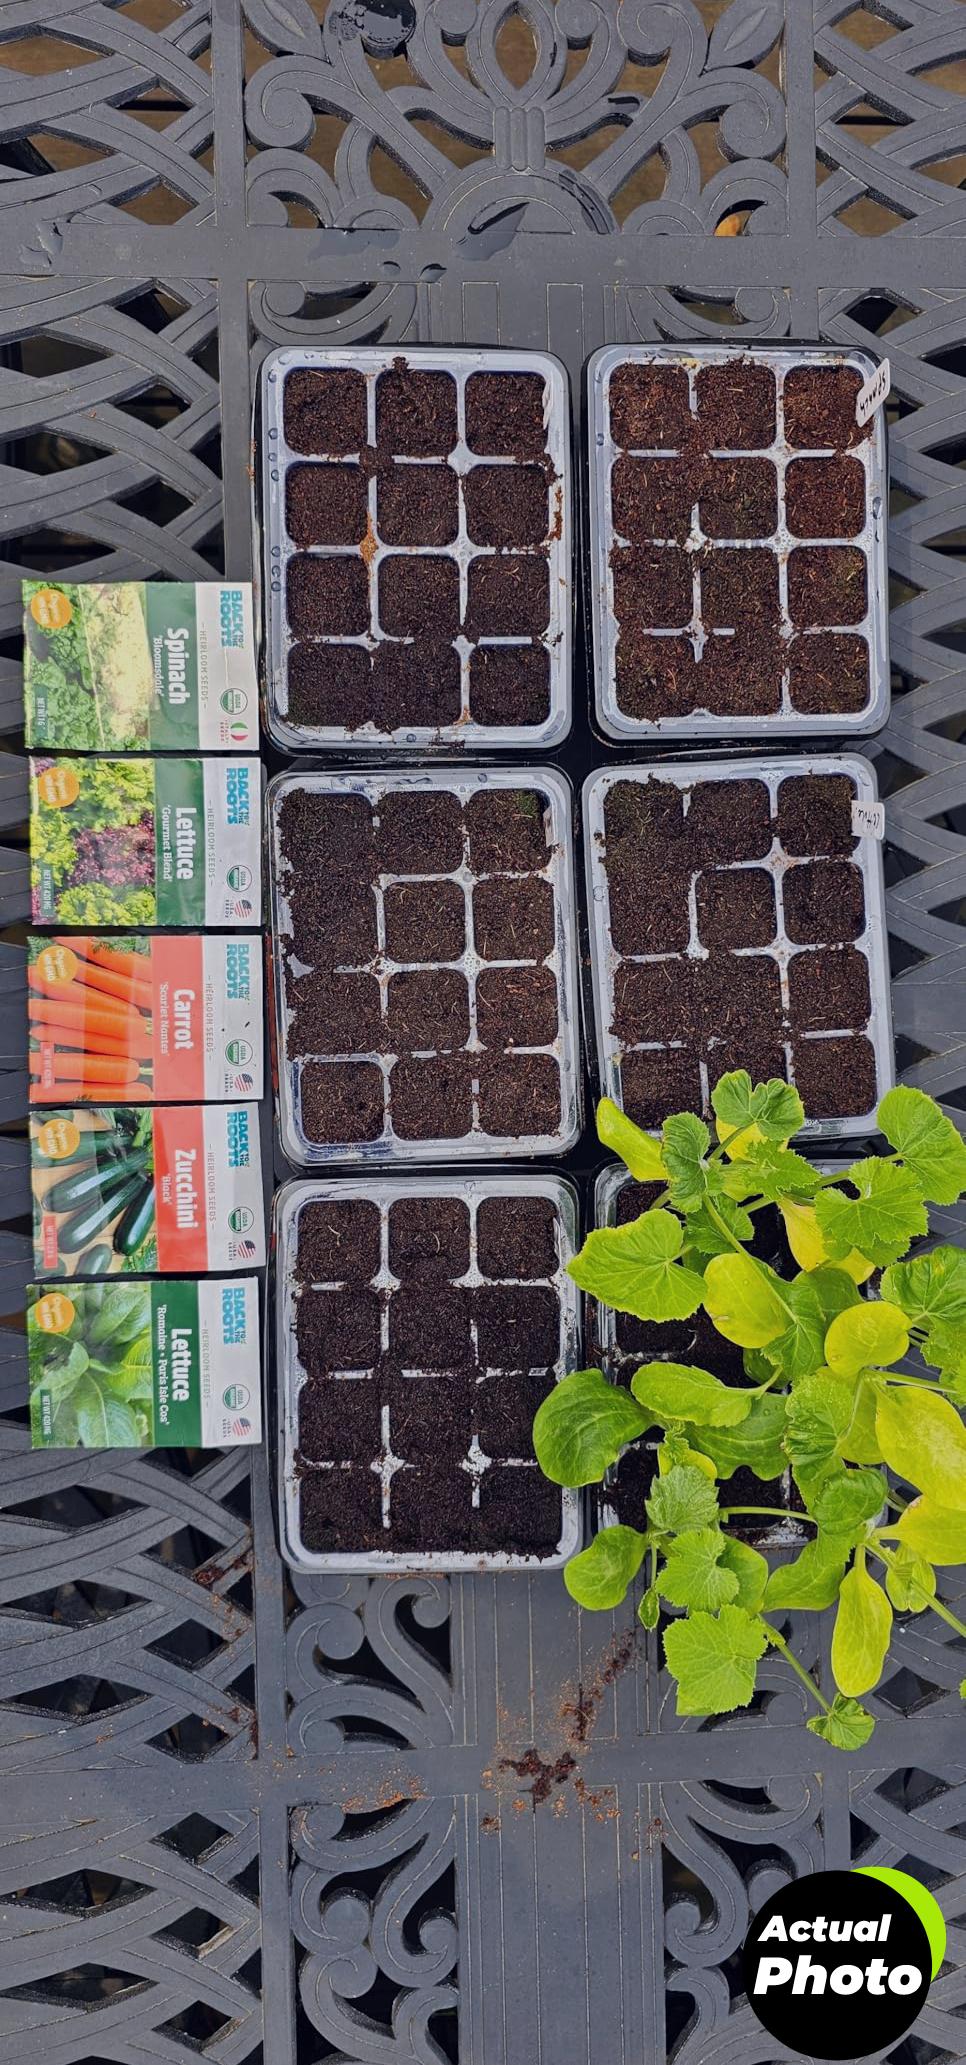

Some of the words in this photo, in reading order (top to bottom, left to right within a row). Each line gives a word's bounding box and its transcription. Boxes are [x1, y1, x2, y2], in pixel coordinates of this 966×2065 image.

[220, 590, 232, 647] ROOTS
[232, 590, 244, 634] BACK
[164, 628, 191, 704] Spinach
[200, 630, 208, 673] HEIRLOOM
[200, 675, 208, 701] SEEDS
[227, 768, 239, 825] ROOTS
[239, 768, 249, 811] BACK
[176, 807, 197, 880] Lettuce
[43, 870, 51, 880] NET
[44, 881, 51, 889] WT
[44, 901, 51, 909] MG
[227, 944, 238, 999] ROOTS
[238, 944, 250, 986] BACK
[174, 989, 195, 1049] Carrot
[206, 983, 214, 1025] HEIRLOOM
[206, 1027, 214, 1053] SEEDS
[227, 1112, 238, 1167] ROOTS
[238, 1111, 248, 1154] BACK
[175, 1148, 198, 1228] Zucchini
[223, 1288, 234, 1345] ROOTS
[234, 1287, 246, 1330] BACK
[171, 1328, 192, 1401] Lettuce
[202, 1329, 210, 1371] HEIRLOOM
[158, 1360, 167, 1384] Paris
[43, 1395, 51, 1405] NET
[159, 1386, 168, 1403] Isle
[44, 1425, 51, 1435] MG
